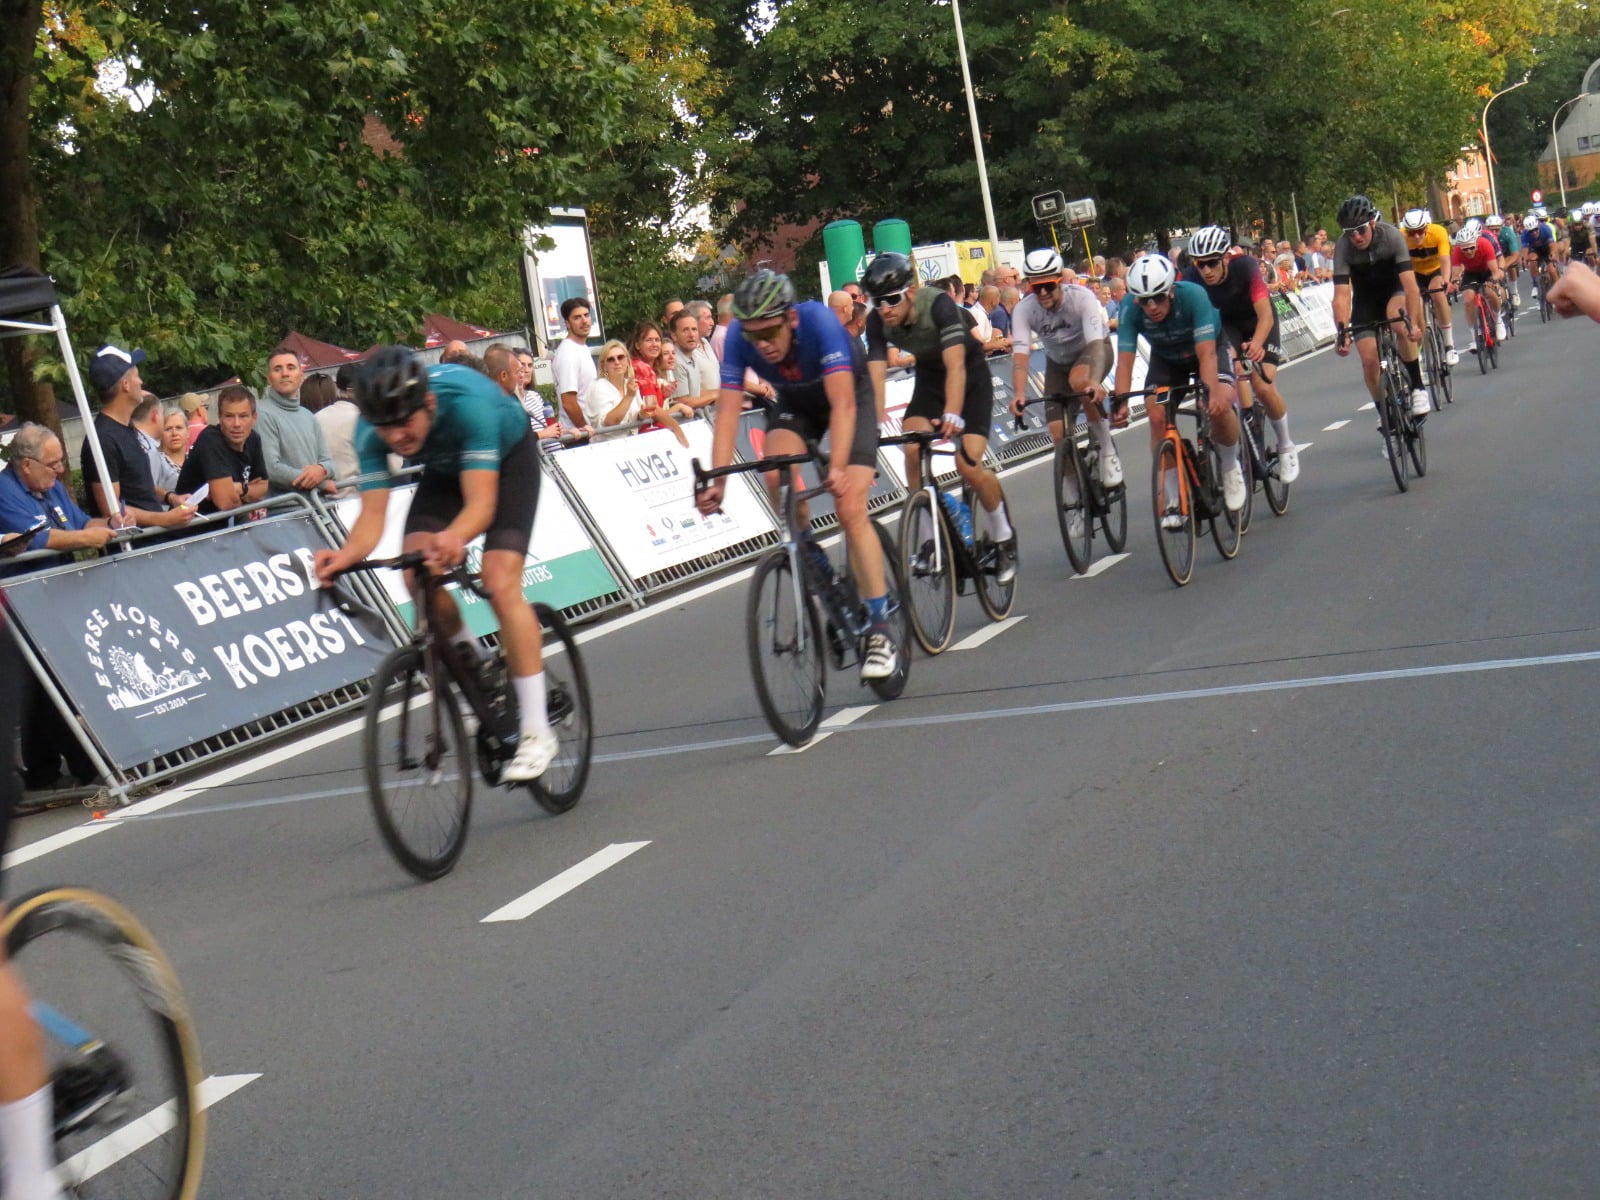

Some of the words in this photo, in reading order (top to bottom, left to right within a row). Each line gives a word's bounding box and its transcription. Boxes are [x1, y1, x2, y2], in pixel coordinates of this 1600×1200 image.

[616, 450, 679, 488] HUYBS
[84, 608, 124, 711] BEERSE
[110, 602, 212, 682] KOERST
[213, 603, 366, 689] KOERST
